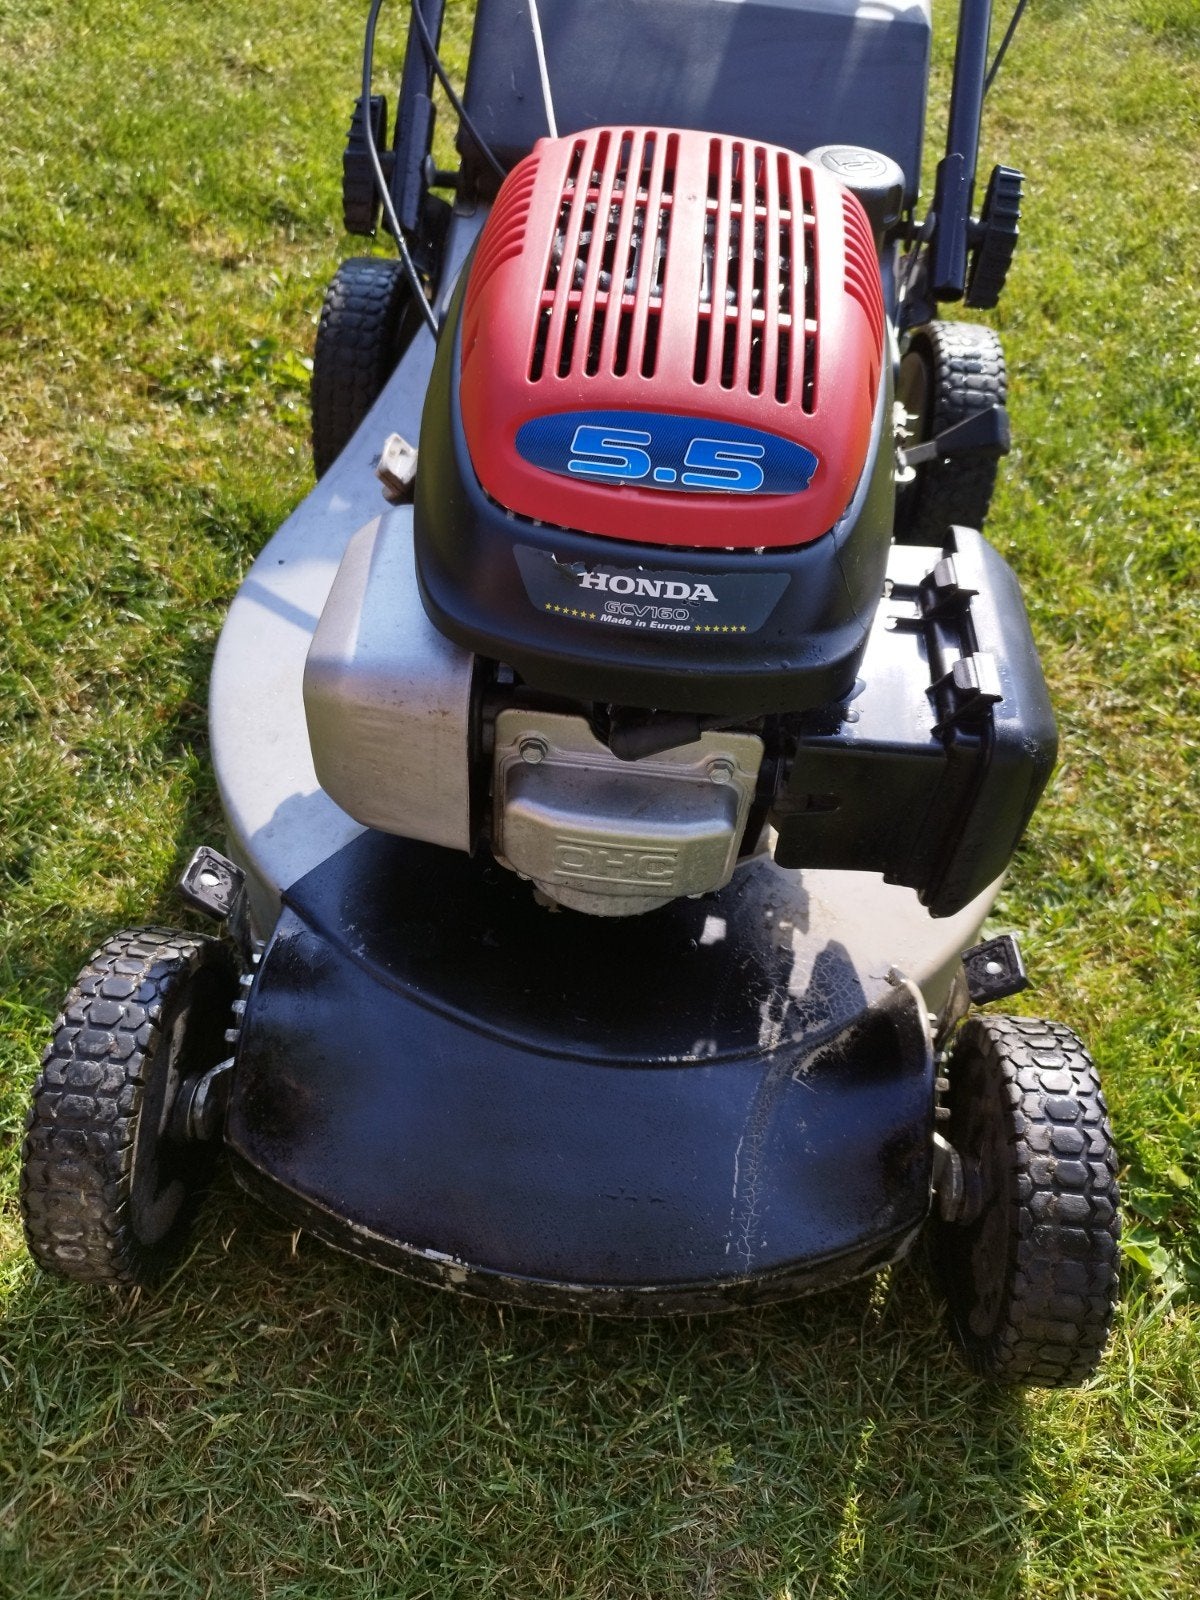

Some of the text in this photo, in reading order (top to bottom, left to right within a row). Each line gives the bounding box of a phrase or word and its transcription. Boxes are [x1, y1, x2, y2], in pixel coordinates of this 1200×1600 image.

[568, 425, 765, 491] 5.5
[578, 572, 718, 602] HONDA
[600, 614, 691, 632] Made in Europe
[604, 600, 689, 621] GCV160
[554, 845, 677, 879] OHC
